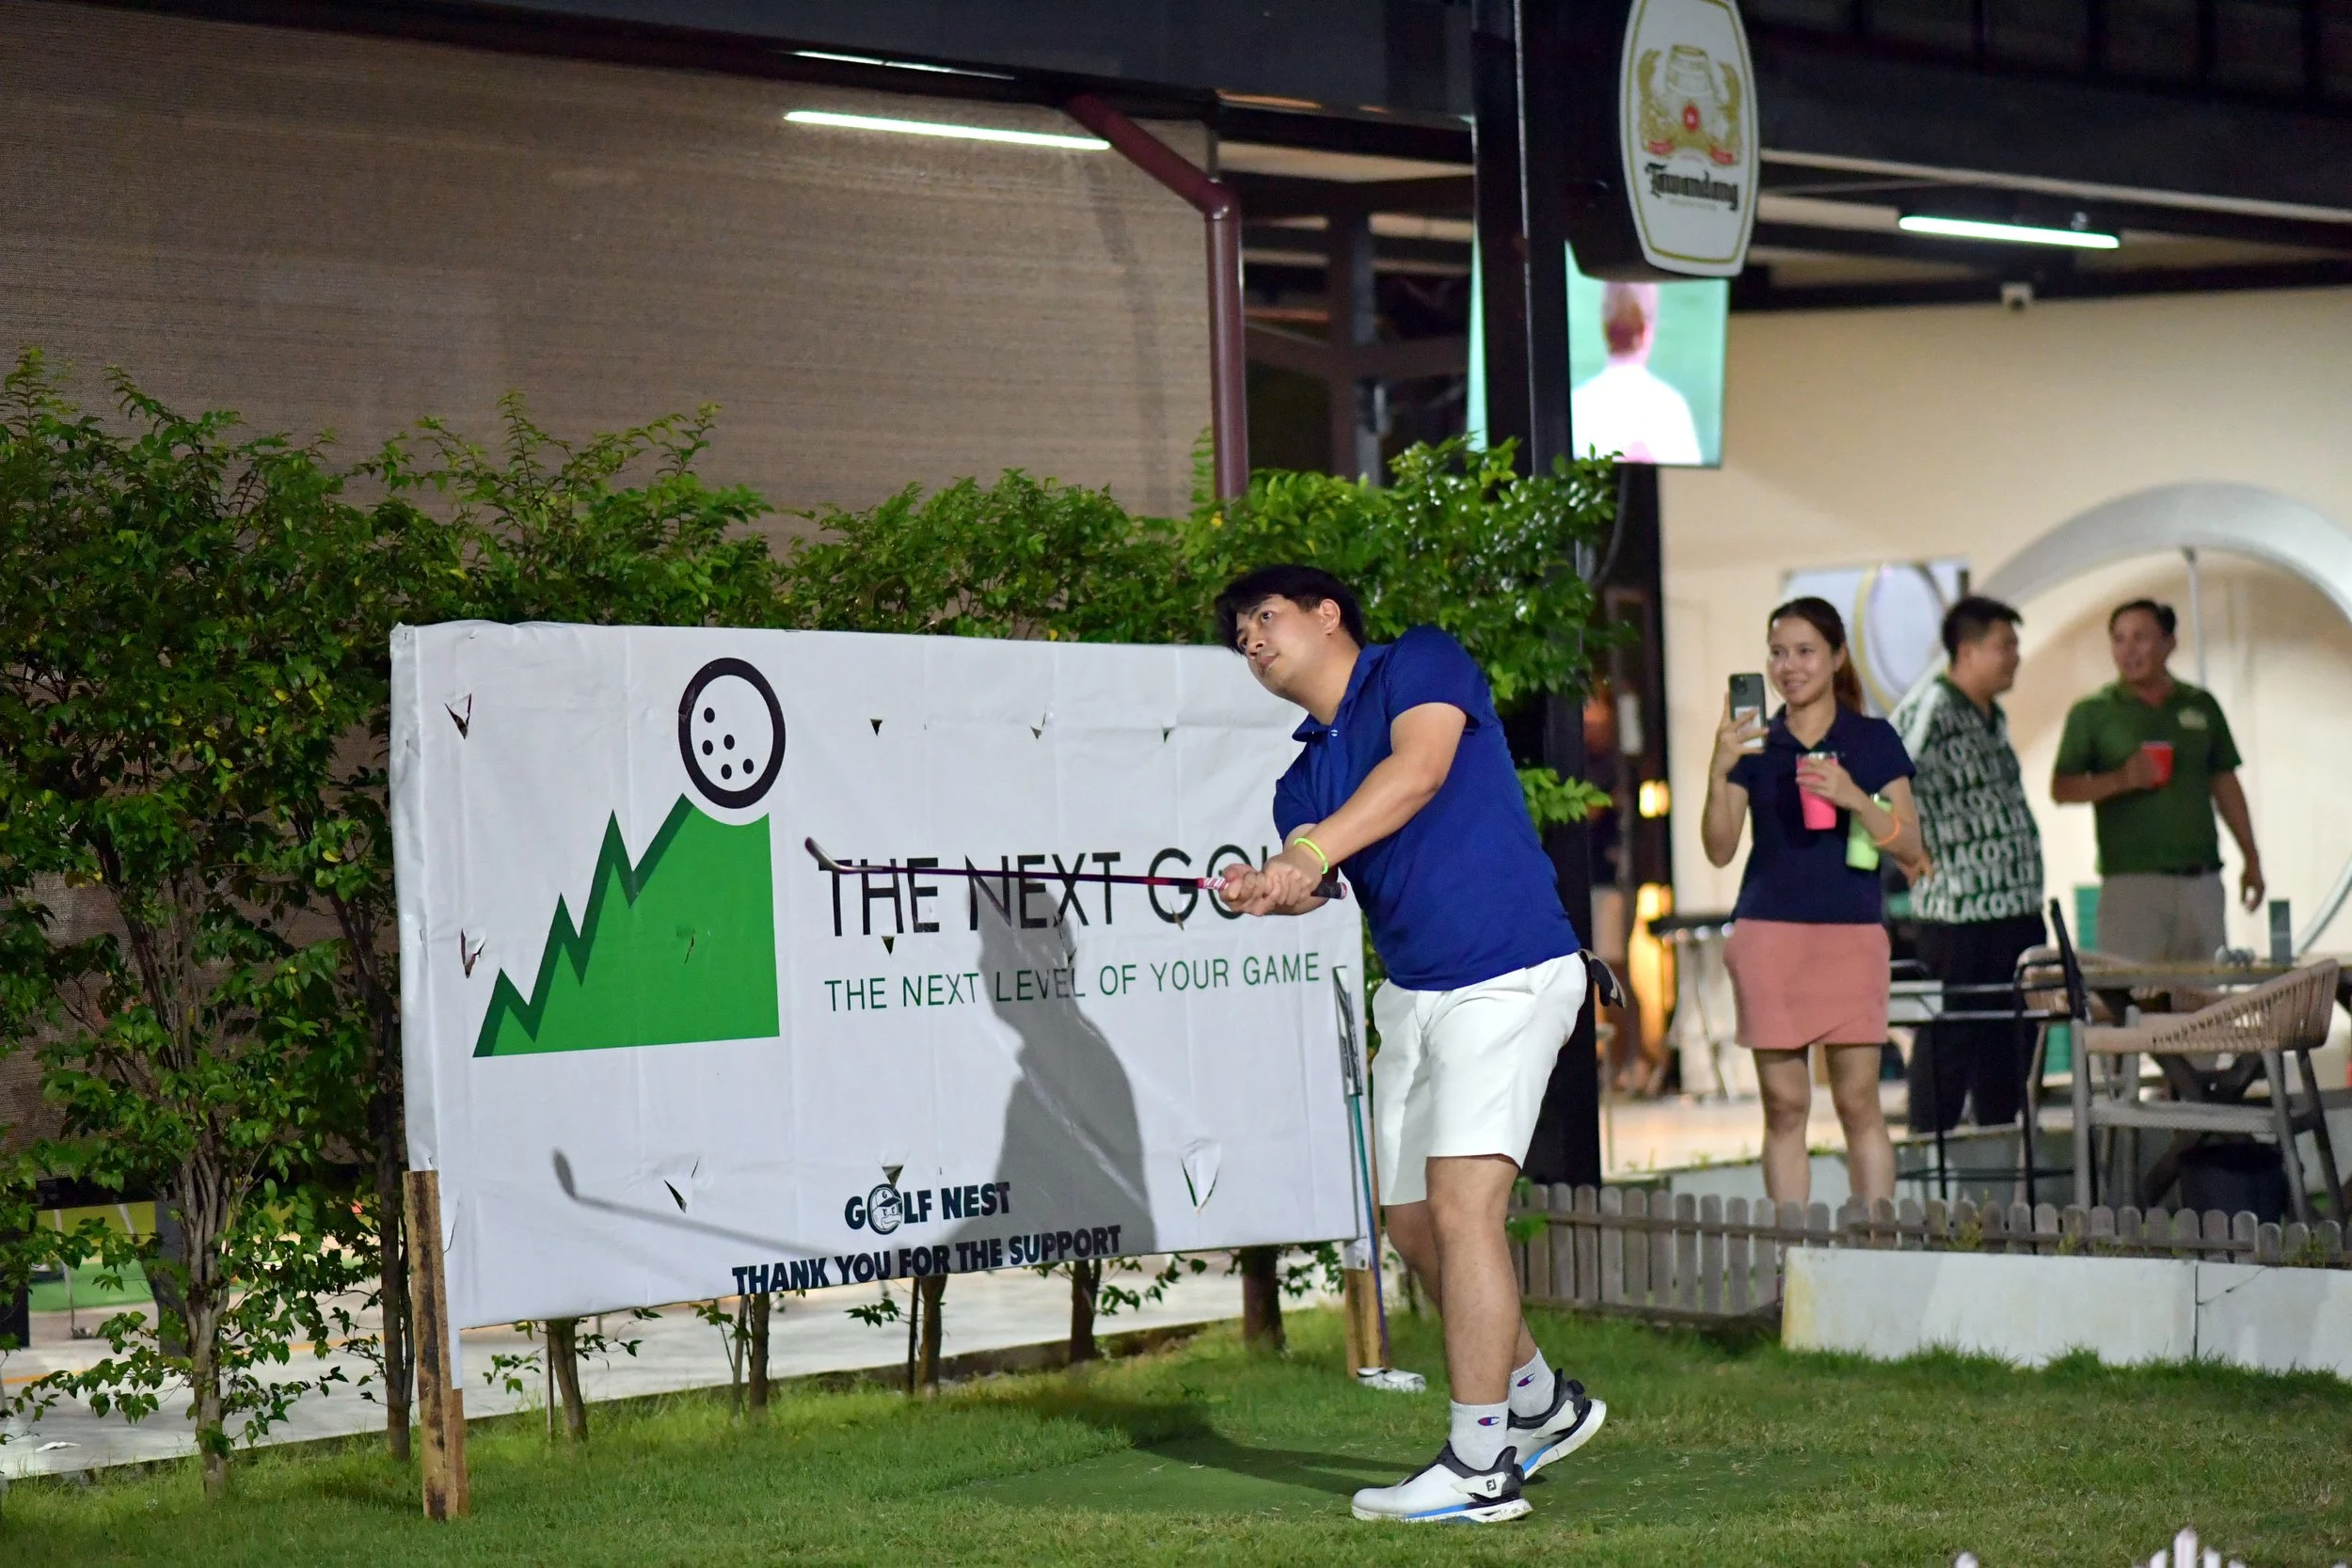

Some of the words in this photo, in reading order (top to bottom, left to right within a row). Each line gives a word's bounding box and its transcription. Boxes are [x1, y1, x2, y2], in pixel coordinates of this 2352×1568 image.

[818, 856, 940, 937] THE
[964, 851, 1120, 931] NEXT
[825, 977, 888, 1012] THE
[902, 972, 979, 1006] NEXT
[995, 967, 1087, 1003] LEVEL
[1099, 963, 1137, 995] OF
[1150, 958, 1230, 992] YOUR
[1243, 952, 1321, 985] GAME
[845, 1182, 932, 1235] GOLF
[941, 1181, 1011, 1222] NEST
[731, 1258, 830, 1296] THANK
[835, 1250, 891, 1284] YOU
[898, 1244, 951, 1277] FOR
[955, 1237, 1003, 1272] THE
[1009, 1225, 1122, 1266] SUPPORT
[1486, 1478, 1497, 1492] FJ
